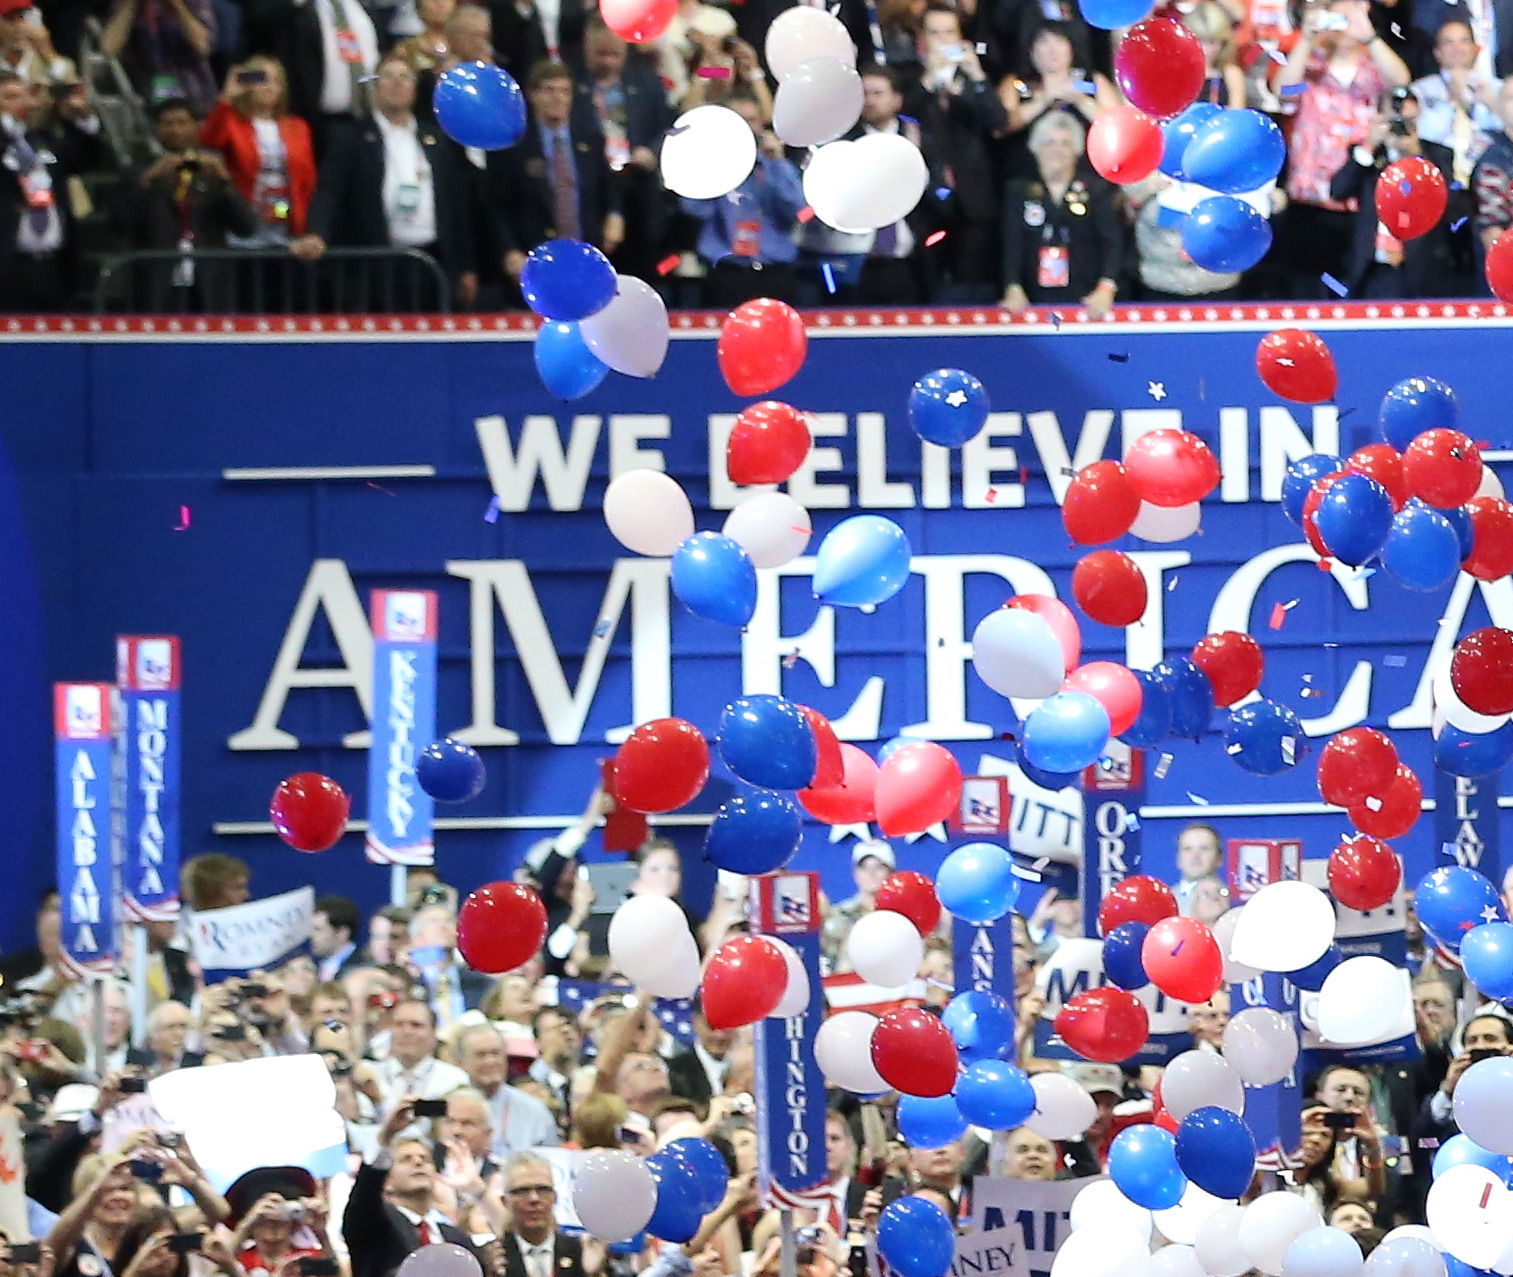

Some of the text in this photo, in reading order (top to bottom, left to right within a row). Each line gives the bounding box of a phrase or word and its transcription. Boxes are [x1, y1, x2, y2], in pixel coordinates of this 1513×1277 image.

[1220, 405, 1338, 503] IN
[71, 749, 101, 953] ALABAMA
[137, 700, 167, 895] MONTANA
[1009, 793, 1080, 848] ITT
[784, 1012, 809, 1177] HINGTON
